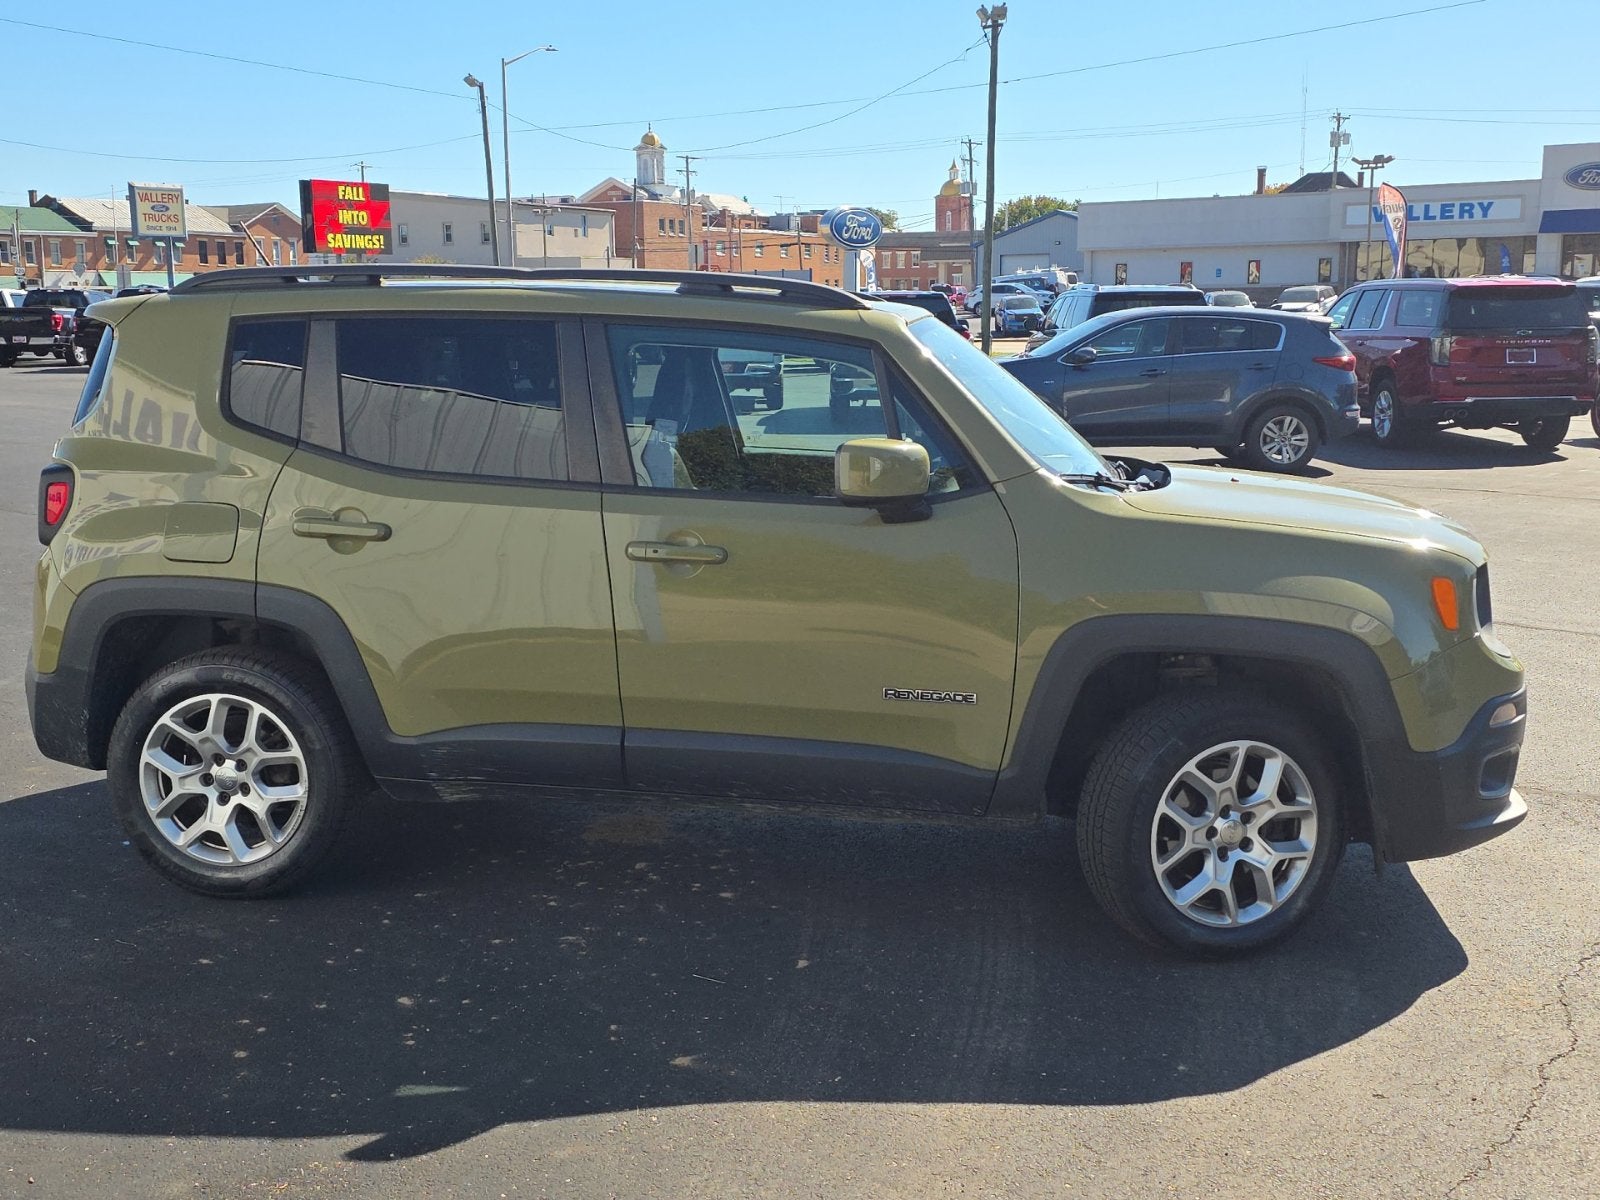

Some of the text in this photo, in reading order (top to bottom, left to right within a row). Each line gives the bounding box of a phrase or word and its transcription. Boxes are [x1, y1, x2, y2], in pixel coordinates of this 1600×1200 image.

[137, 192, 180, 203] VALLERY
[338, 185, 365, 201] FALL
[142, 213, 179, 223] TRUCKS
[338, 209, 368, 226] INTO
[1372, 201, 1494, 222] VLLERY
[842, 214, 874, 241] Ford
[327, 233, 384, 249] SAVINGS!
[883, 687, 976, 704] RENEGADE
